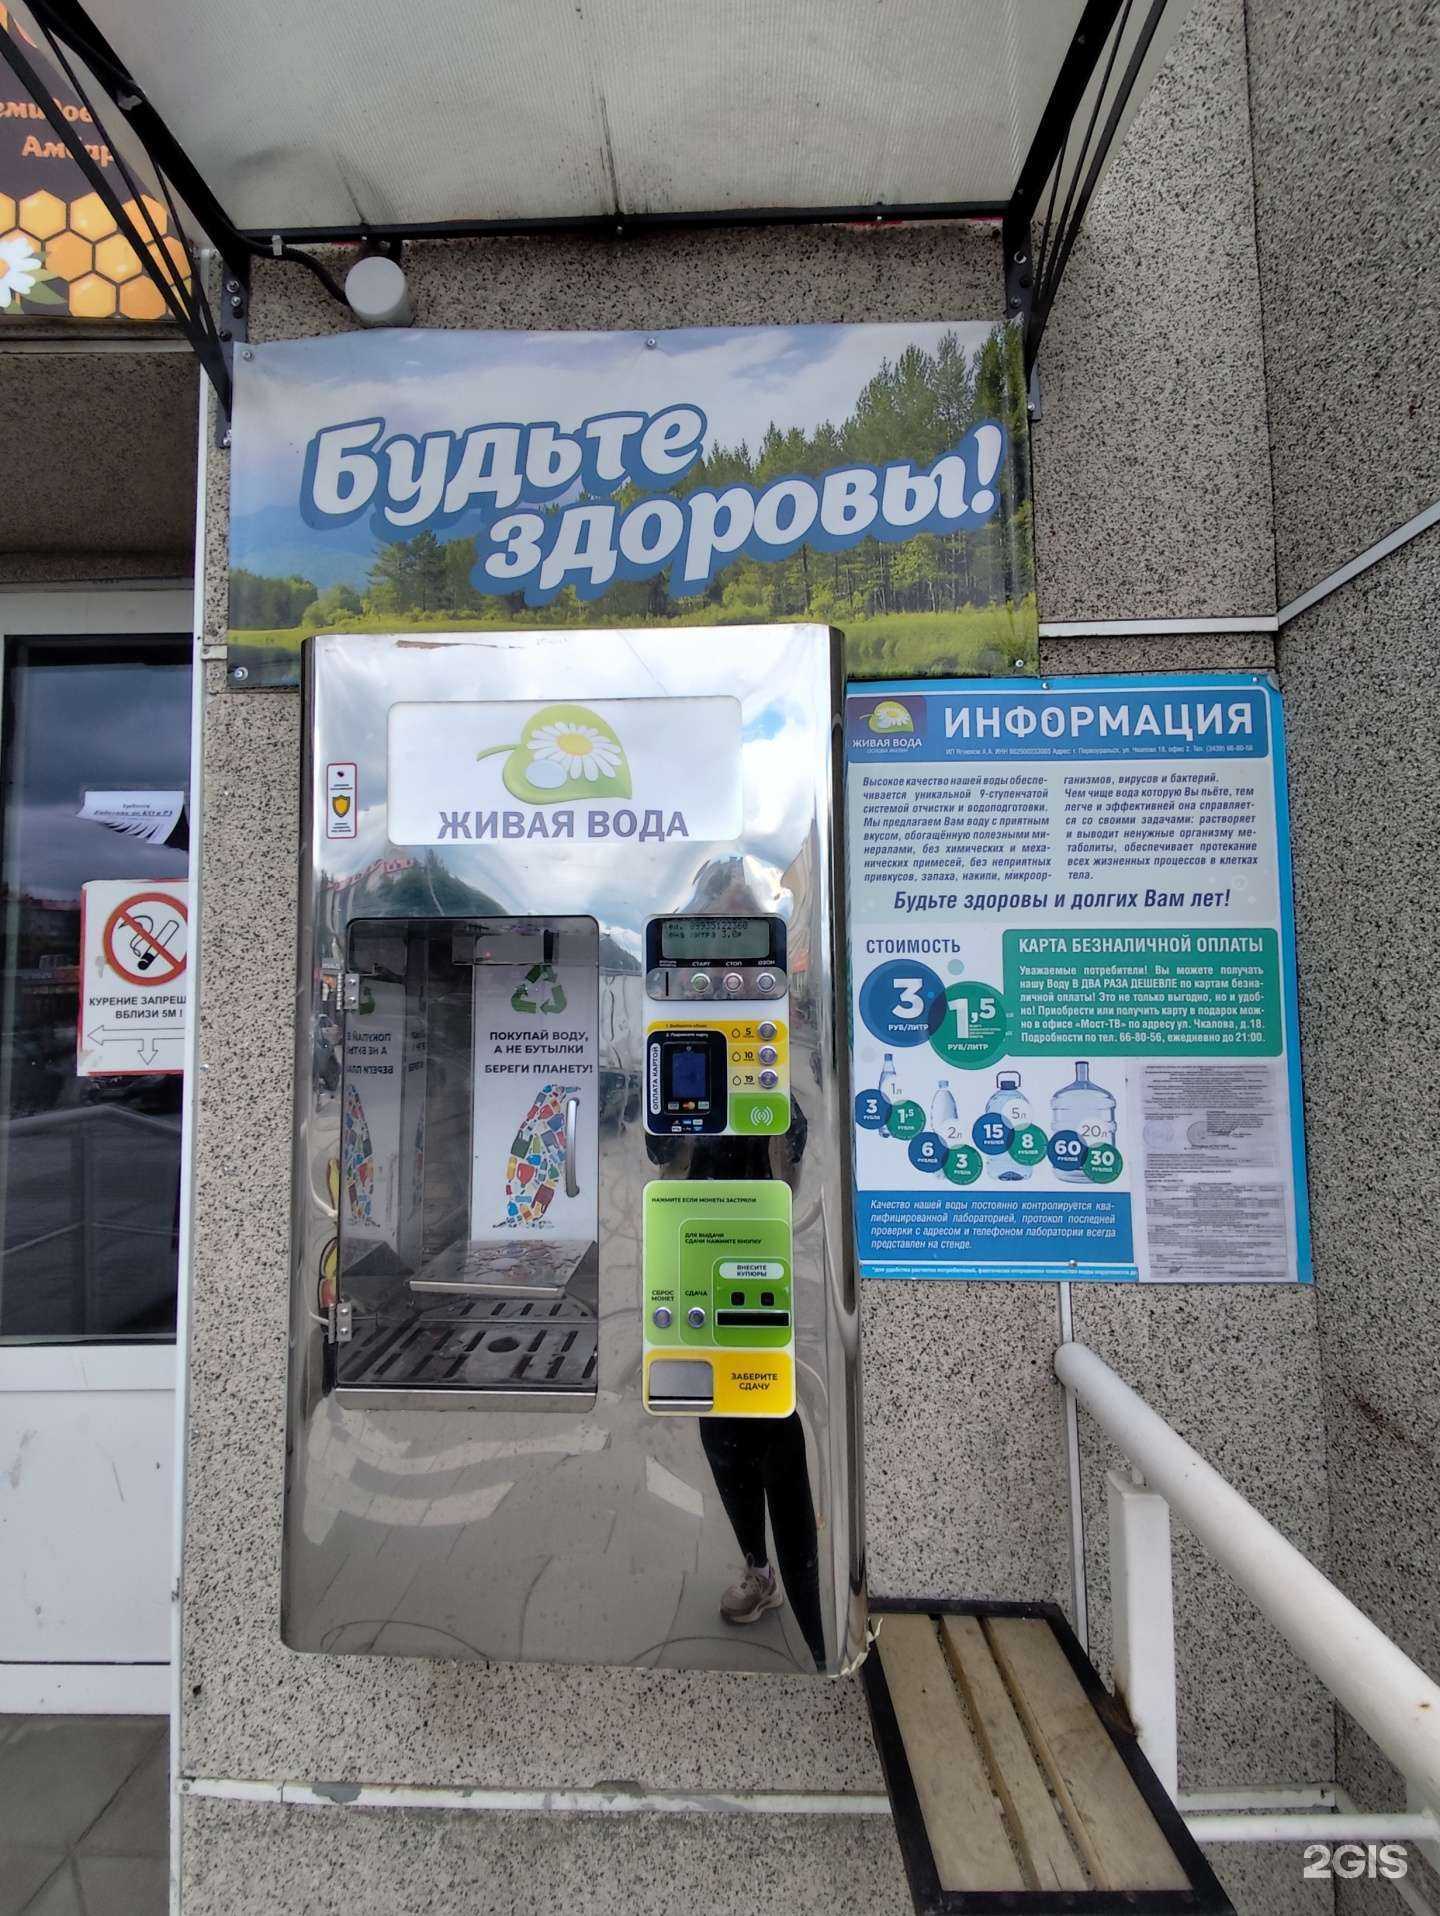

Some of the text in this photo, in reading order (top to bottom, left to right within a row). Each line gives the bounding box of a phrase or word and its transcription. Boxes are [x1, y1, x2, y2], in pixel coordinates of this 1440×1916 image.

[312, 403, 701, 525] Будьте
[484, 425, 1001, 589] здоровы!
[945, 703, 1252, 741] ИНФОРМАЦИЯ
[852, 739, 922, 748] ЖИВАЯ ВОДА
[863, 777, 904, 786] Высокое
[906, 778, 948, 786] качество
[1010, 775, 1047, 785] обеспе-
[1064, 772, 1219, 785] ганизмов, вирусов бактерий.
[864, 788, 1048, 801] чивается уникальной 9-ступенчатой
[1141, 786, 1232, 799] которую пьёте,
[864, 805, 909, 814] системой
[967, 804, 1047, 813] водоподготовки.
[1065, 801, 1254, 813] легче эффективней справляет-
[437, 810, 689, 842] ЖИВАЯ ВОДА
[883, 817, 1049, 829] предлагаем приятным
[1098, 815, 1256, 825] своими задачами: растворяет
[864, 830, 1029, 842] вкусом, обогащённую полезными
[1077, 829, 1233, 840] выводит ненужные организму
[864, 844, 1050, 856] нералами, химических меха-
[1068, 842, 1257, 853] таболиты, обеспечивает протекание
[864, 858, 1051, 869] нических примесей, неприятных
[1093, 856, 1257, 867] жизненных процессов клетках
[865, 872, 1051, 883] привкусов, запаха, накипи, микроор-
[1069, 872, 1093, 880] тела.
[894, 889, 1230, 913] Будьте здоровы и долгих Вам лет!
[866, 939, 961, 953] СТОИМОСТЬ
[1019, 937, 1263, 952] КАРТА БЕЗНАЛИЧНОЙ ОПЛАТЫ
[89, 997, 138, 1006] КУРЕНИЕ
[892, 978, 924, 1019] 3
[115, 1010, 159, 1019] ВБЛИЗИ
[489, 1029, 588, 1042] ПОКУПАЙ ВОДУ,
[494, 1045, 584, 1054] А НЕ БУТЫЛКИ
[485, 1064, 593, 1073] БЕРЕГИ ПЛАНЕТУ!
[866, 1099, 878, 1114] 3
[984, 1124, 1003, 1139] 15
[1022, 1134, 1034, 1149] 8
[1054, 1140, 1081, 1155] 60
[921, 1142, 934, 1157] 6
[956, 1154, 968, 1169] 3
[1090, 1150, 1115, 1166] 30
